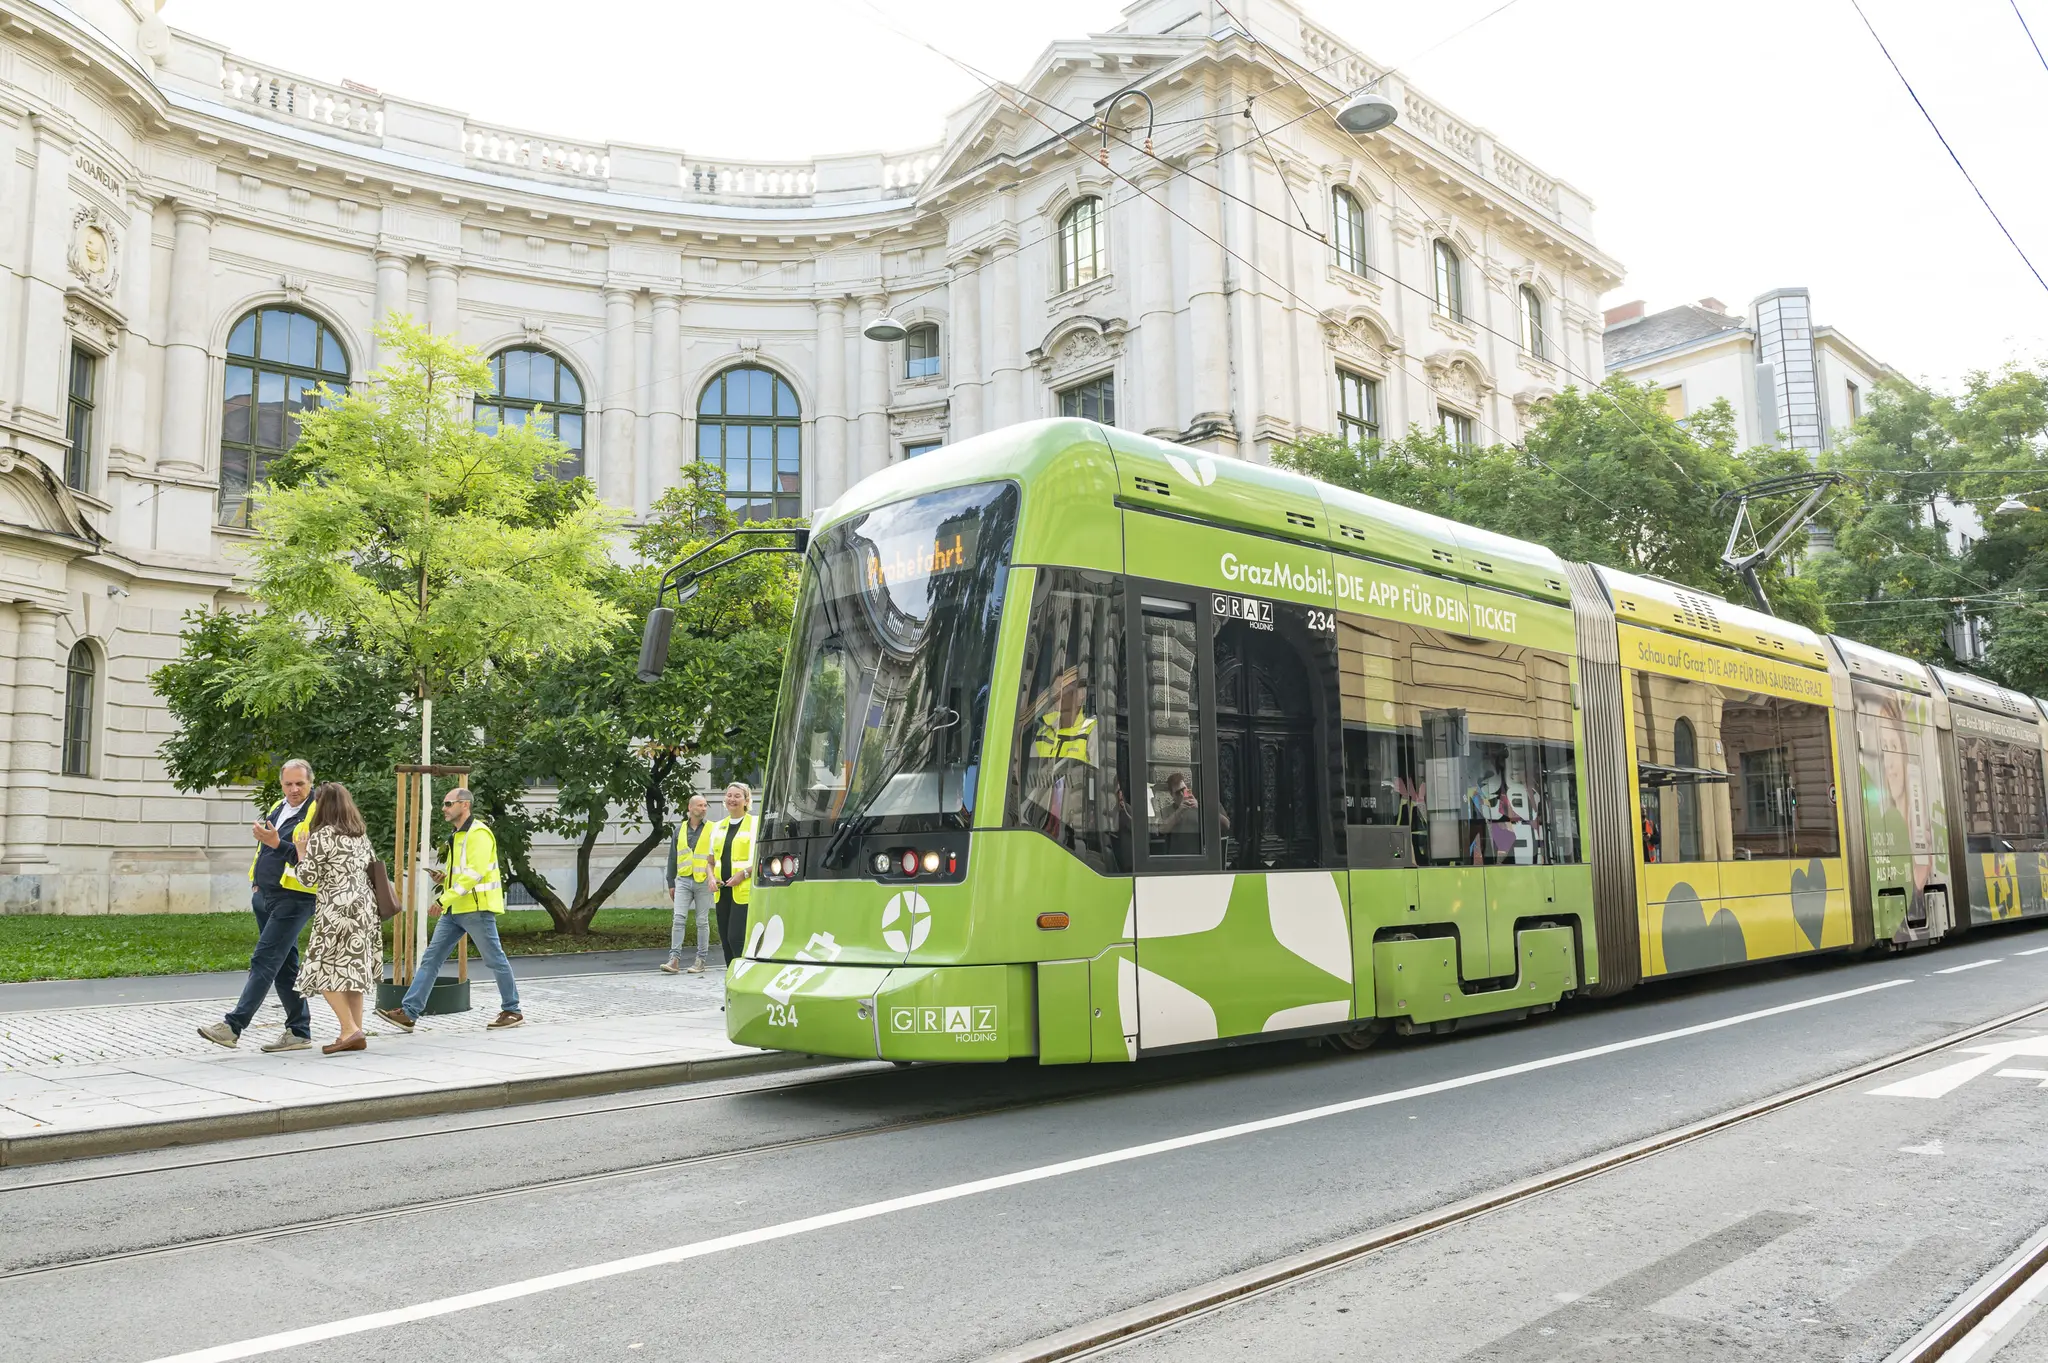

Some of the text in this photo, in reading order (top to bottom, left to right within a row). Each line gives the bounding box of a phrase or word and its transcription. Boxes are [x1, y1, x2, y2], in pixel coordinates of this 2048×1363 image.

[75, 156, 120, 198] JOANEUM
[1220, 552, 1517, 634] GrazMobil: DIE APP FÜR DEIN TICKET
[1213, 594, 1336, 632] GRAZ 234
[1249, 620, 1274, 632] HOLDING
[1637, 641, 1823, 697] Schau auf Graz: DIE APP FÜR EIN SAUBERES GRAZ
[1876, 866, 1887, 881] ALS
[766, 1003, 997, 1033] 234 GRAZ
[955, 1032, 997, 1042] HOLDING
